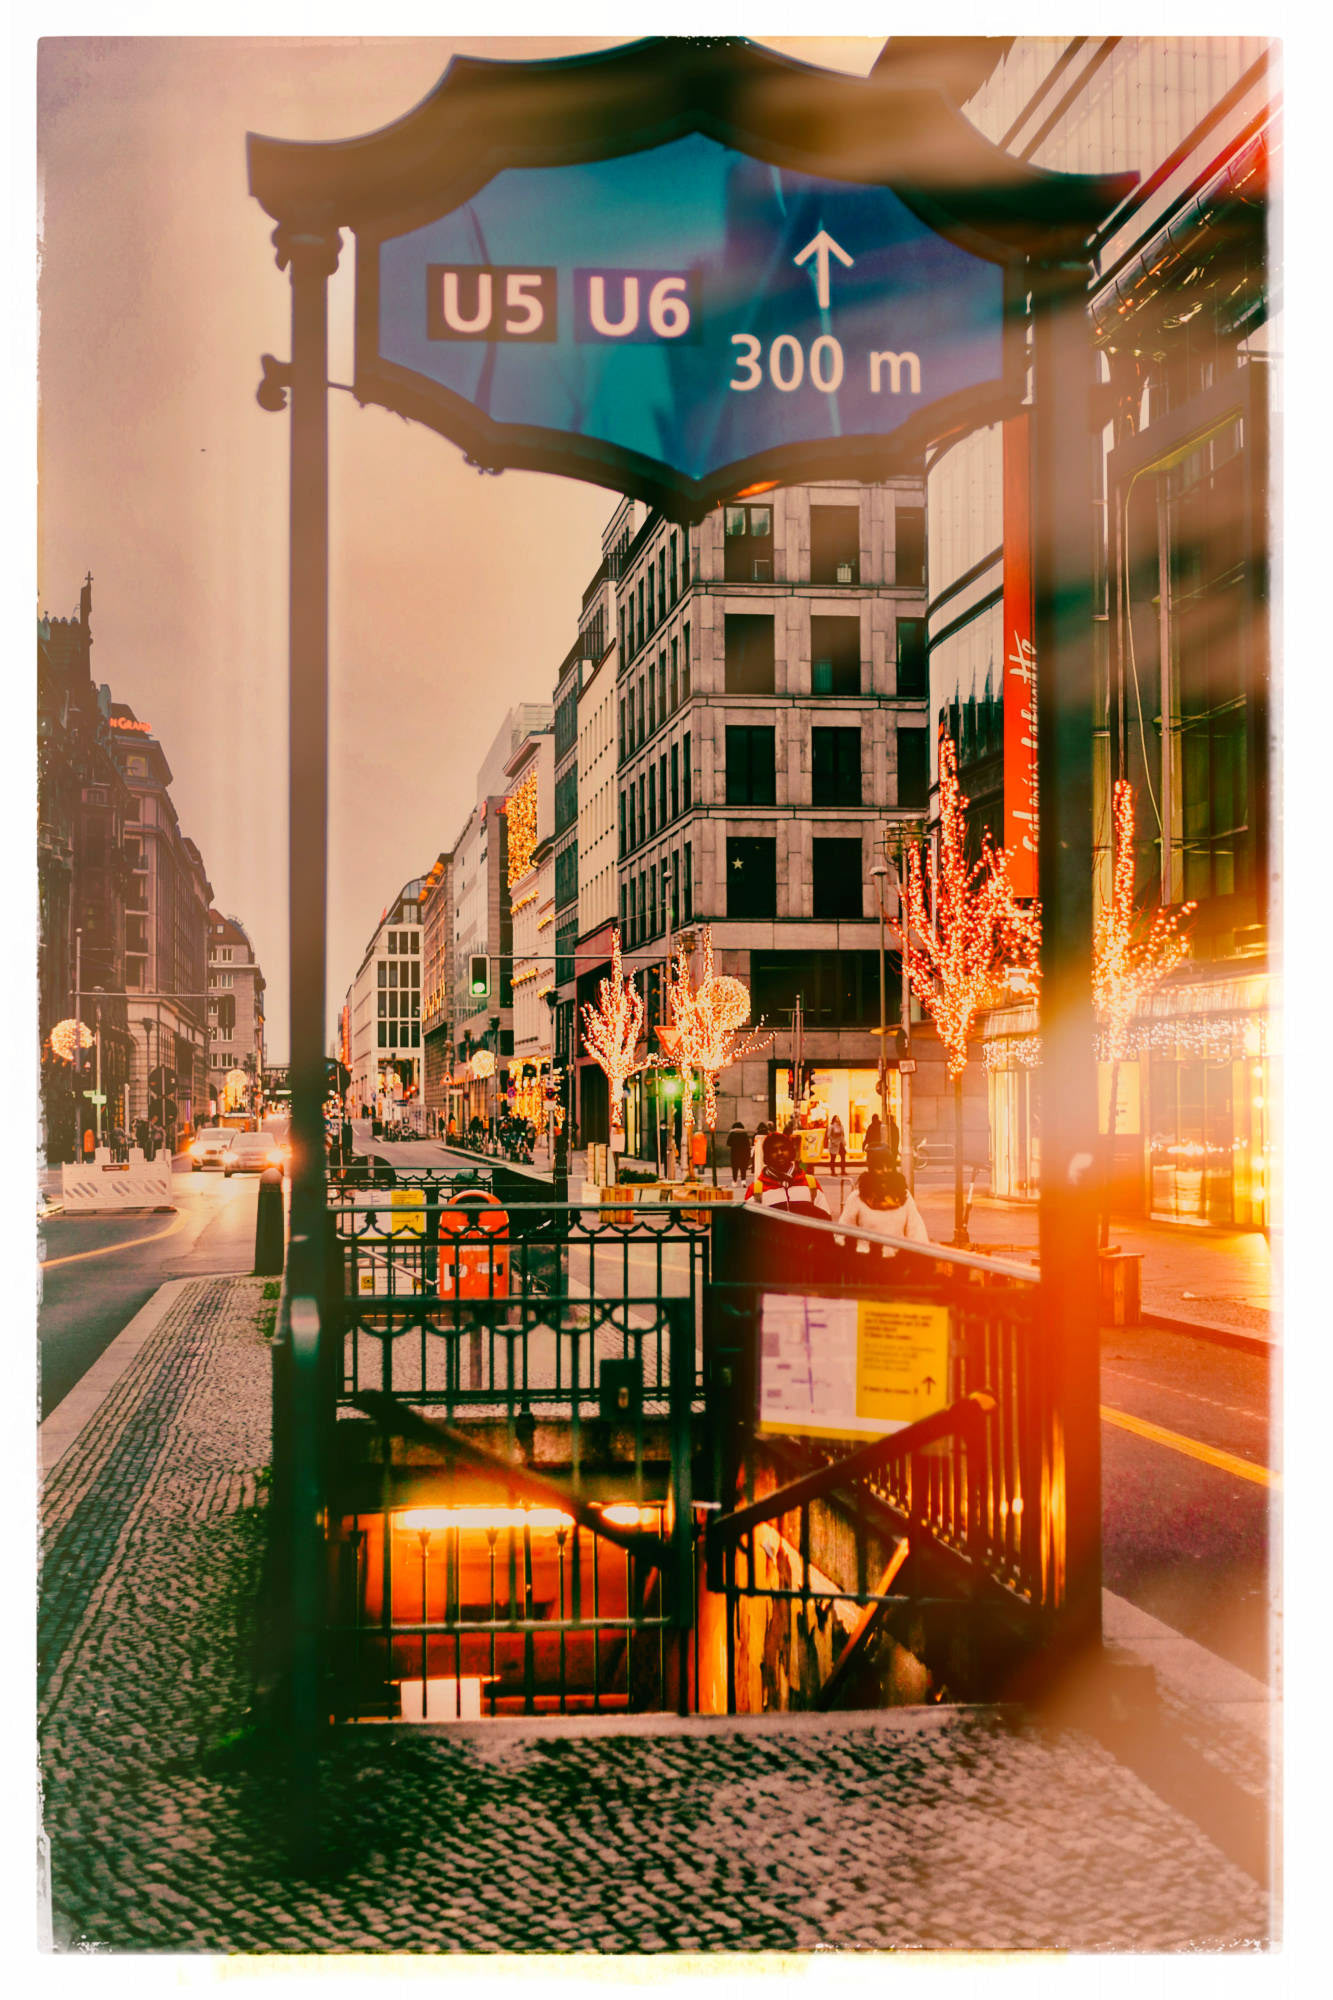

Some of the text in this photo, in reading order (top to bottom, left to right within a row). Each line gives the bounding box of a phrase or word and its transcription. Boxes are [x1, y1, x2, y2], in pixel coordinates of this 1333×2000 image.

[442, 272, 691, 338] U5 U6
[729, 333, 922, 394] 300 m
